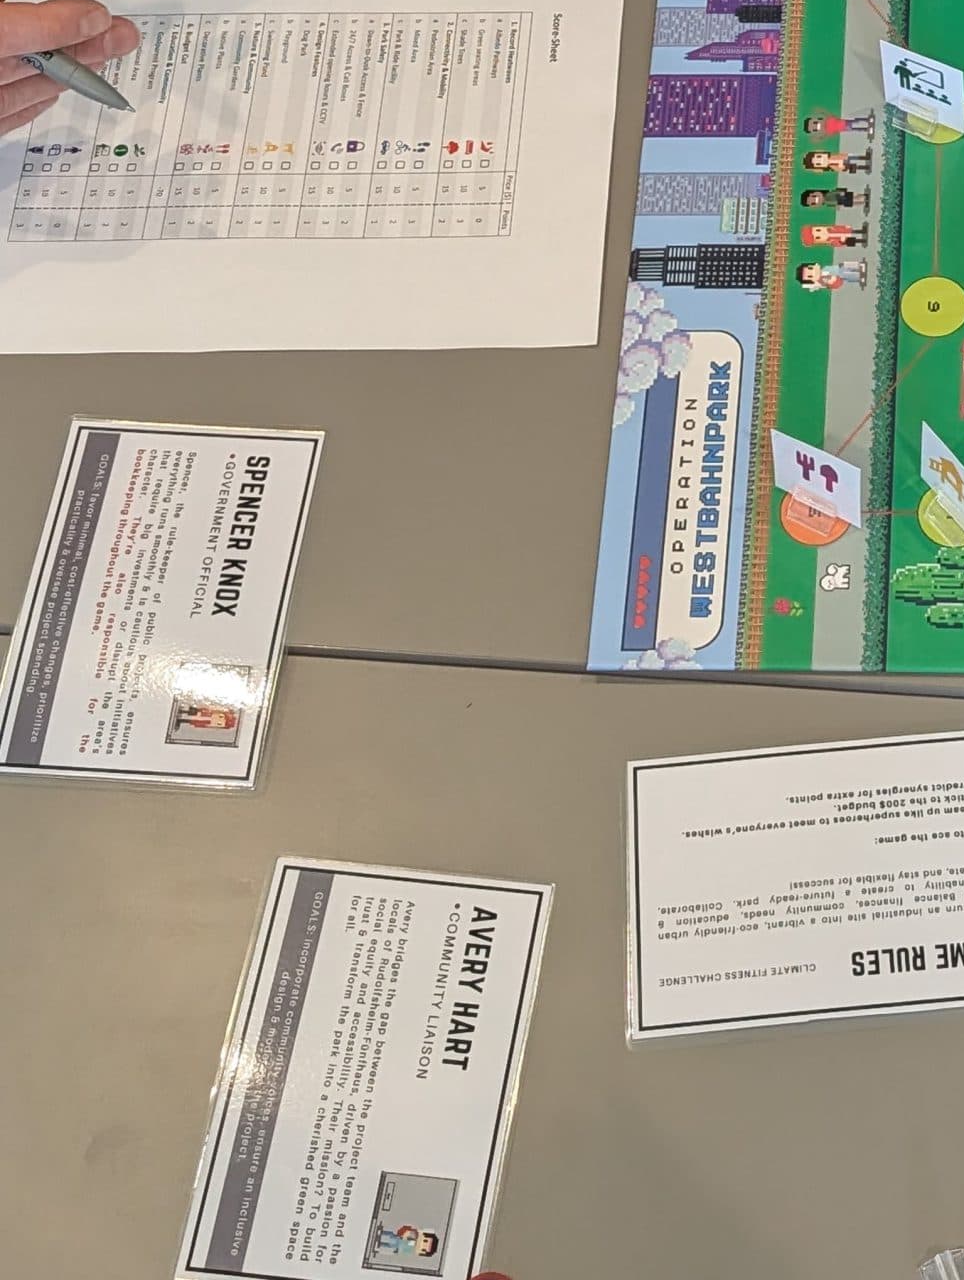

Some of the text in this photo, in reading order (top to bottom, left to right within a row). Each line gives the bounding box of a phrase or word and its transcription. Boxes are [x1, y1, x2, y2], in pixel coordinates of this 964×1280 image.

[549, 13, 562, 62] Score-Sheet
[504, 175, 513, 190] Price
[500, 210, 509, 229] Points
[928, 301, 939, 312] 6
[158, 450, 171, 469] that
[670, 397, 697, 573] OPERATION
[689, 360, 731, 617] WESTBAHNPARK
[146, 478, 163, 514] require
[140, 523, 153, 540] big
[189, 461, 236, 618] GOVERNMENT OFFICIAL
[211, 455, 270, 617] SPENCER KNOX
[89, 448, 146, 635] bookkeeping throughout the game.
[124, 549, 146, 611] investments
[105, 641, 124, 681] disrupt
[101, 691, 113, 709] the
[91, 720, 106, 754] area's
[825, 790, 853, 801] extra
[856, 789, 872, 799] for
[875, 782, 928, 797] synergies
[785, 791, 823, 805] points.
[832, 798, 875, 813] budget.
[878, 797, 906, 810] 200$
[908, 796, 926, 806] the
[929, 795, 941, 804] to
[832, 808, 900, 824] superheroes
[903, 809, 923, 819] like
[926, 805, 940, 815] up
[724, 819, 785, 835] everyone's
[788, 818, 815, 828] meet
[818, 817, 829, 826] to
[681, 827, 721, 840] wishes.
[873, 832, 907, 844] game:
[910, 832, 928, 842] the
[931, 830, 949, 839] ace
[953, 829, 964, 838] to
[849, 945, 926, 976] RULES
[658, 962, 816, 986] CLIMATE FITNESS CHALLENGE
[414, 912, 462, 1079] COMMUNITY LIAISON
[439, 906, 499, 1071] AVERY HART
[327, 900, 416, 1264] Avery bridges the gap between the project team and the
